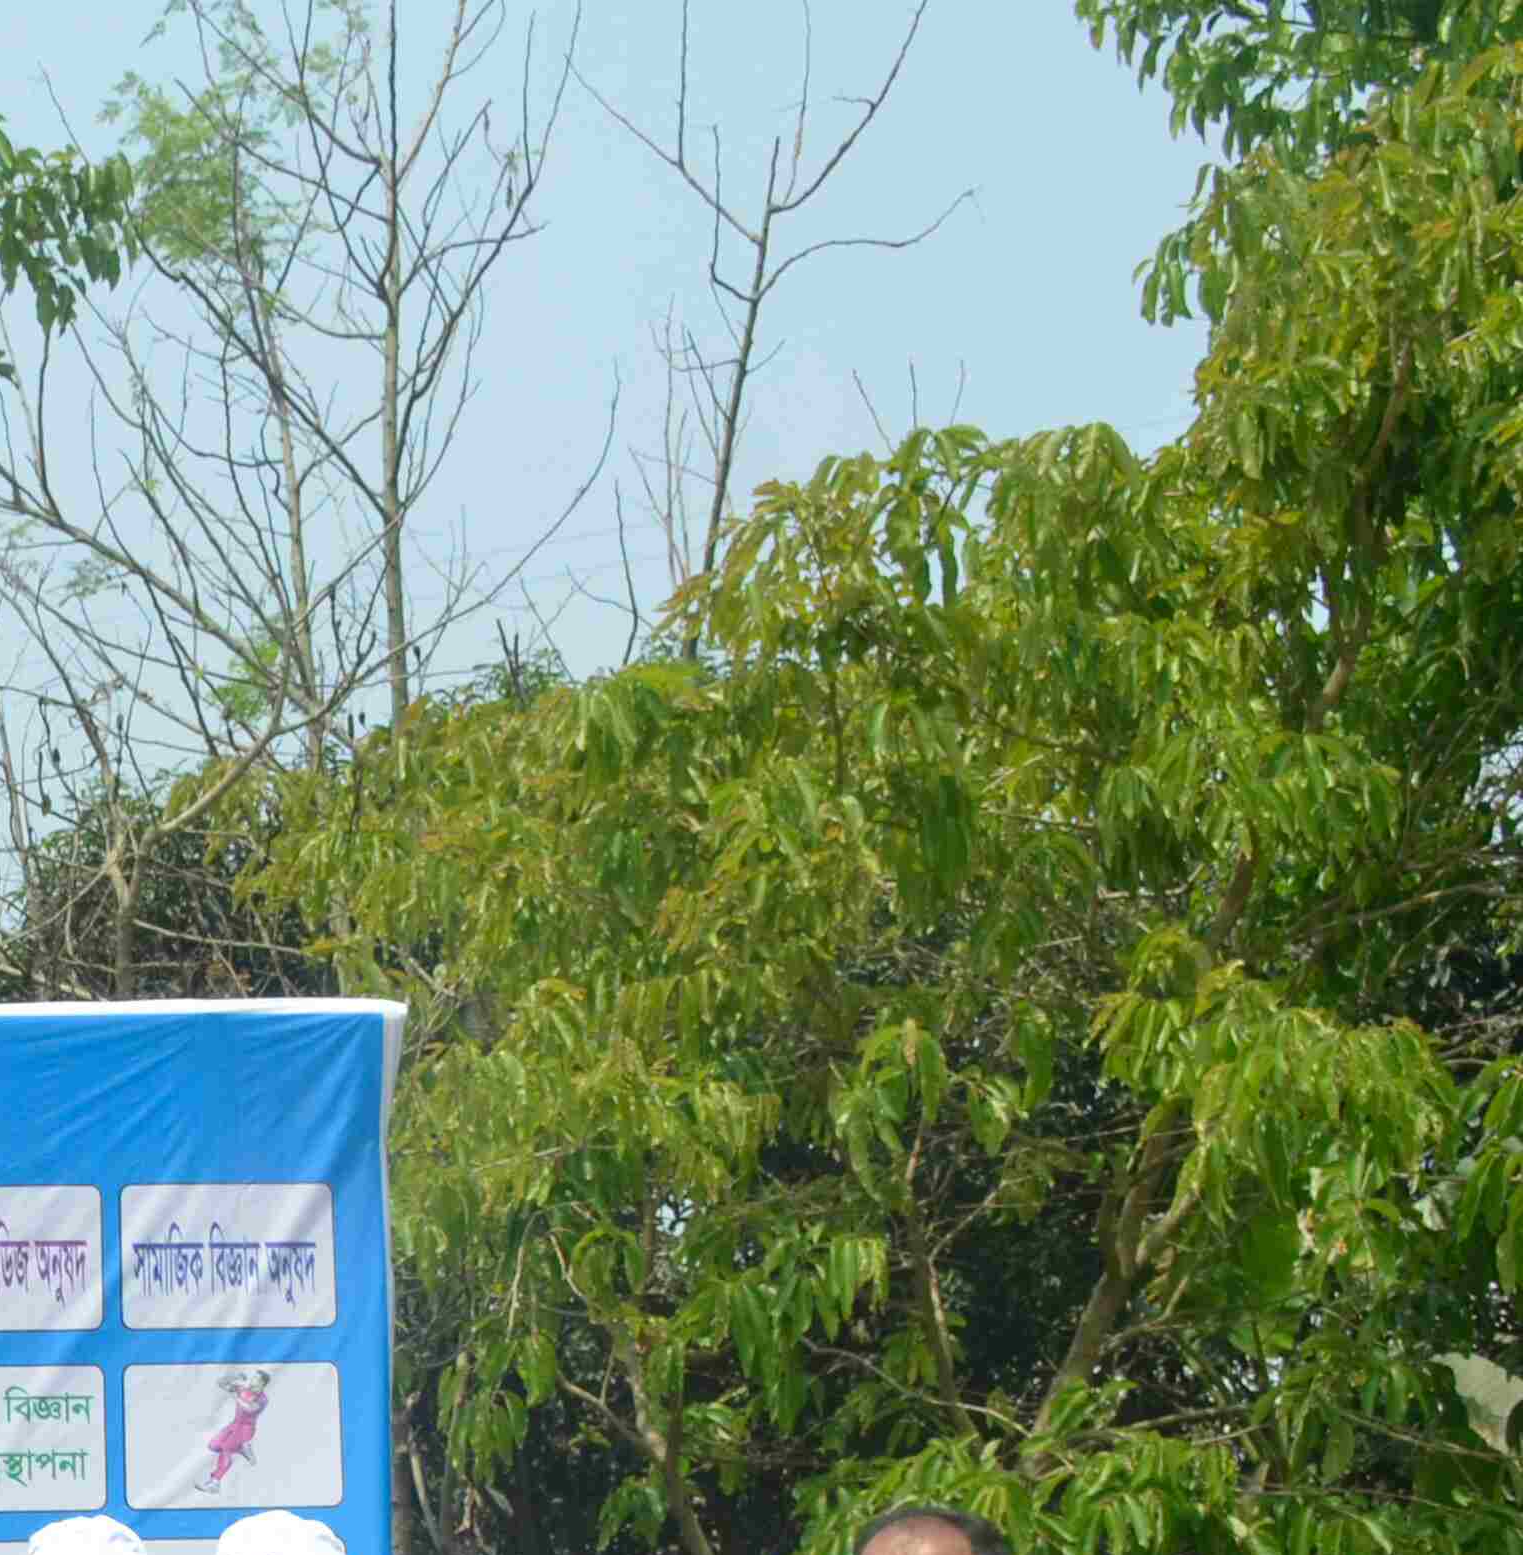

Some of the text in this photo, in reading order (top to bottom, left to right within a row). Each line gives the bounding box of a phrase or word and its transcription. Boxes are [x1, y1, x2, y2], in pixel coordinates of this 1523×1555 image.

[33, 1240, 87, 1311] অনুষদ
[132, 1221, 316, 1309] সামাজিক বিজ্ঞান অনুষদ
[2, 1385, 94, 1424] বিজ্ঞান
